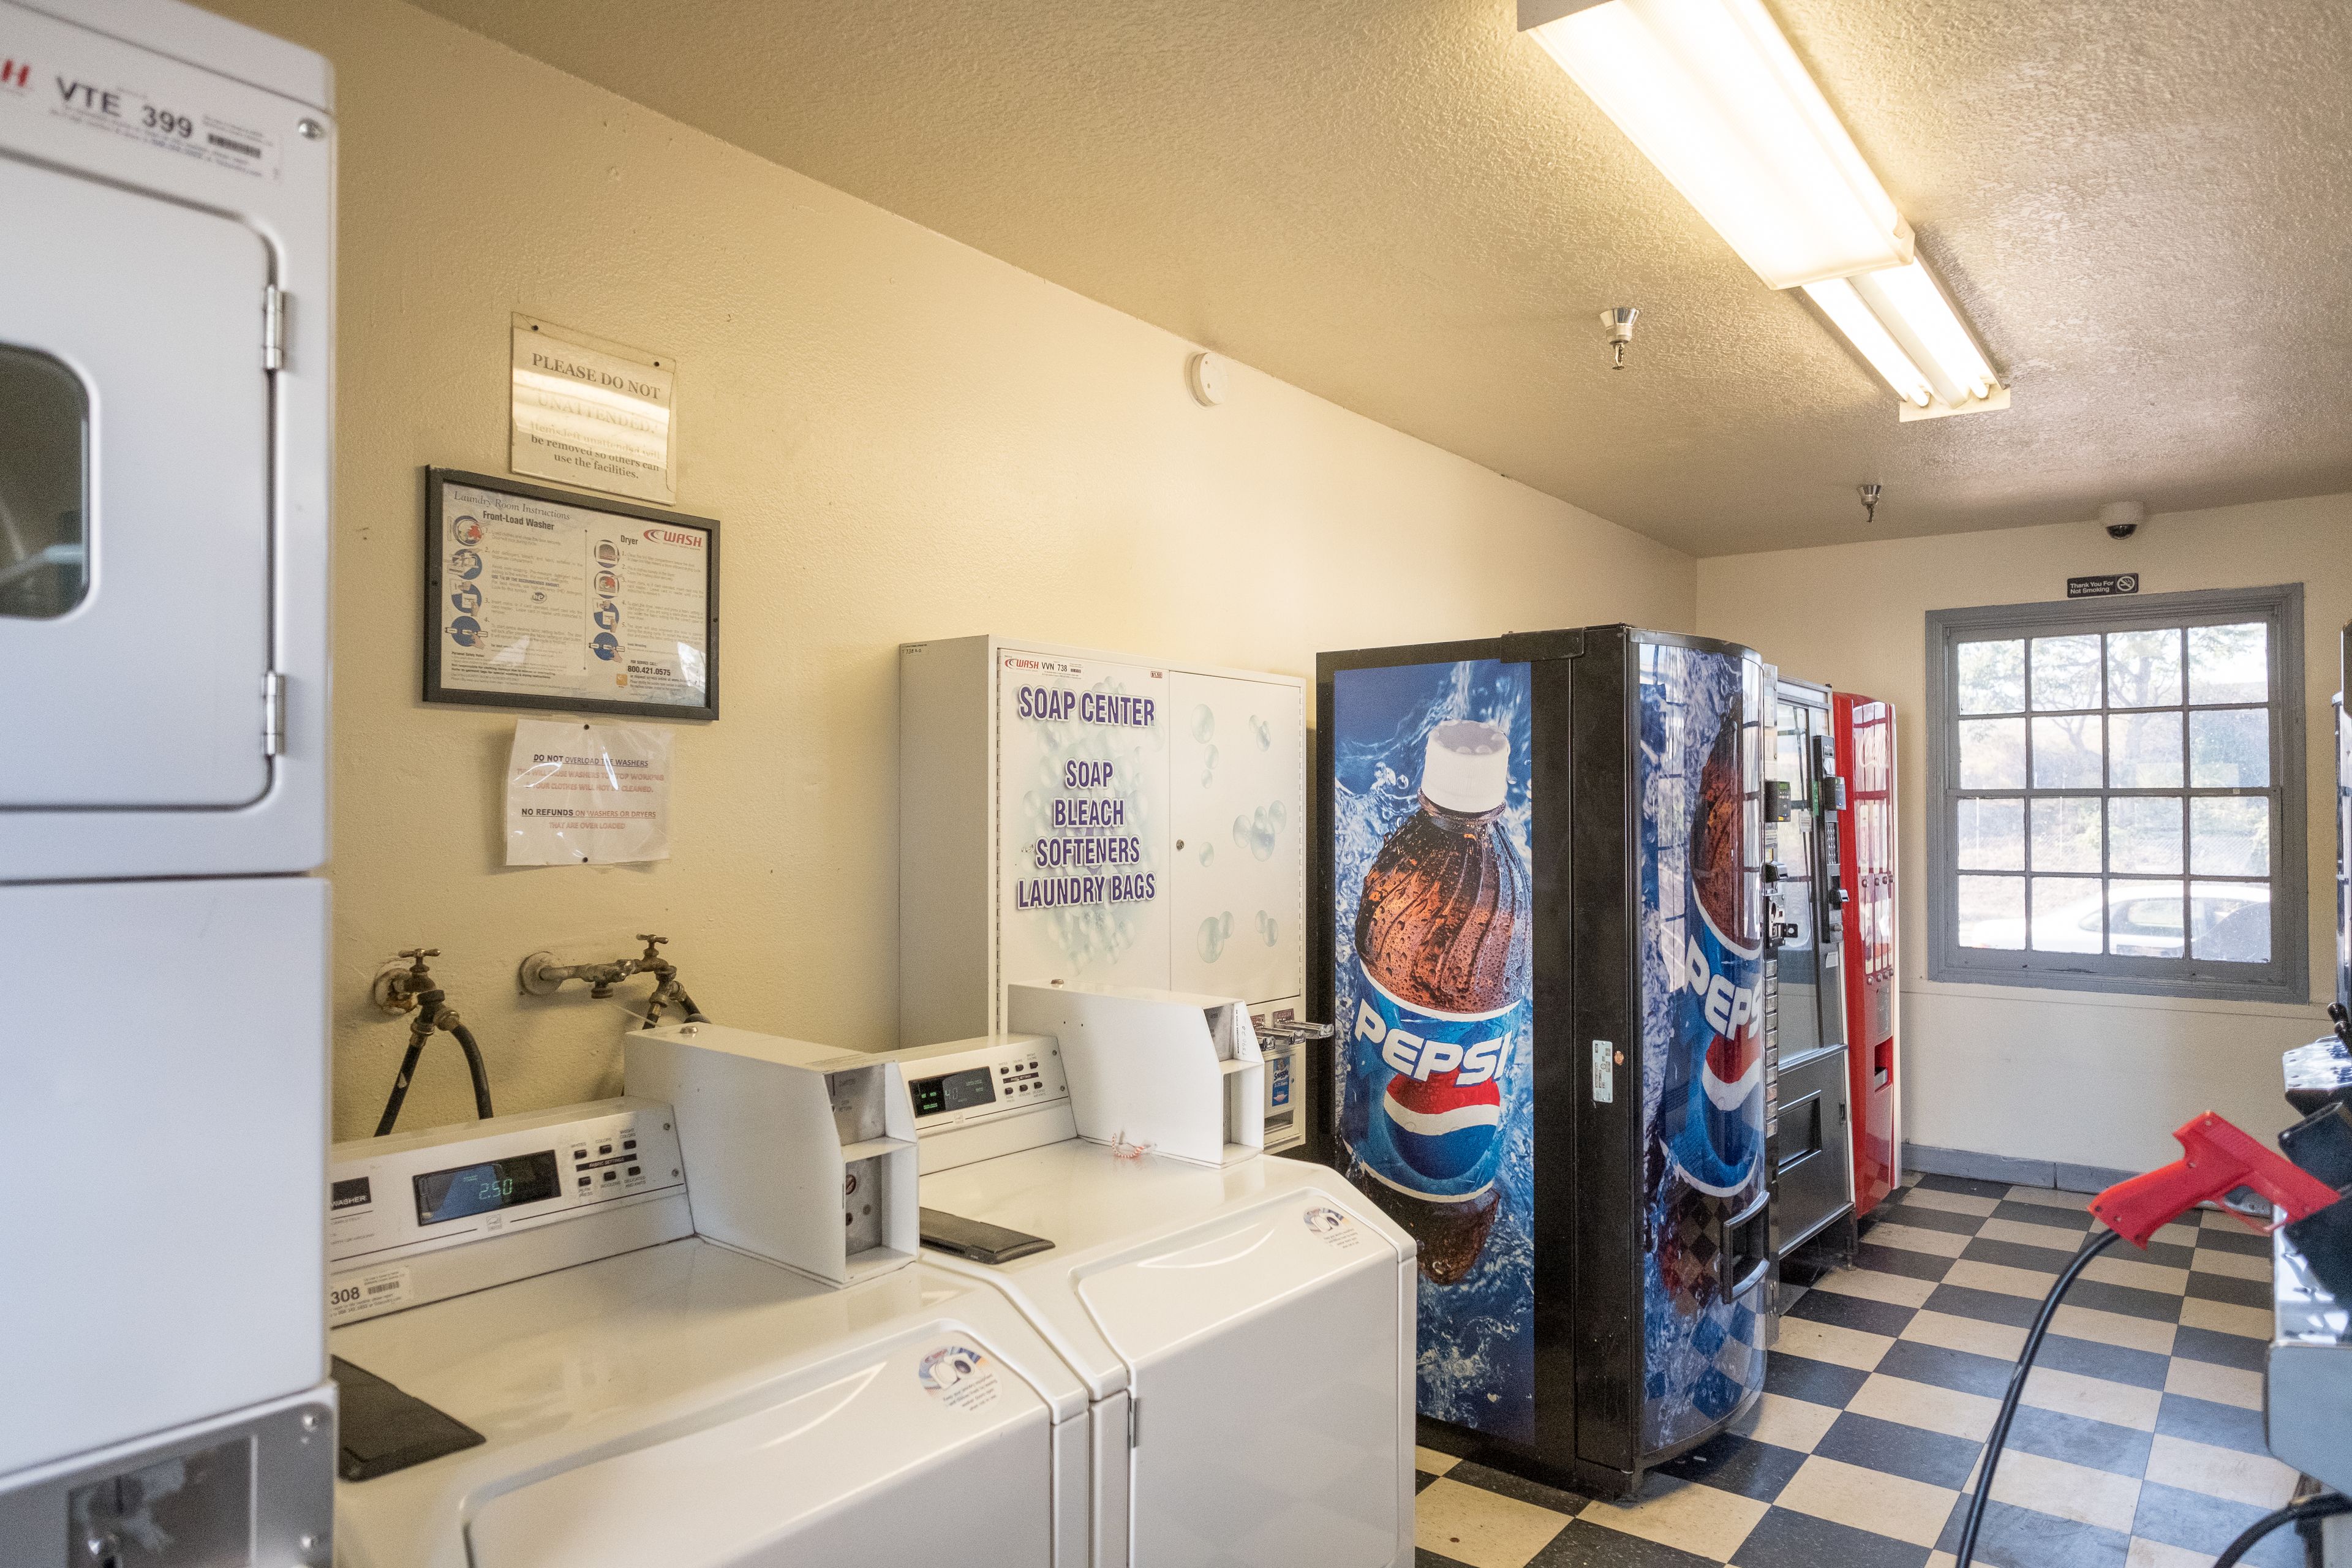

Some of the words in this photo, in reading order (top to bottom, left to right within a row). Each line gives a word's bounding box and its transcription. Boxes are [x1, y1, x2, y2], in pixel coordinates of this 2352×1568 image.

[55, 75, 122, 118] VTE
[141, 104, 194, 140] 399
[532, 353, 597, 382] PLEASE
[601, 372, 624, 389] DO
[628, 380, 660, 399] NOT
[531, 434, 544, 445] be
[546, 439, 592, 456] removed
[608, 454, 640, 468] others
[643, 462, 659, 472] can
[554, 454, 572, 464] use
[575, 458, 591, 468] the
[594, 461, 639, 479] facilities.
[454, 491, 491, 508] Laundry
[495, 499, 520, 511] Room
[522, 503, 570, 520] Instructions
[483, 510, 524, 526] Front-Load
[526, 518, 555, 530] Washer
[620, 535, 638, 546] Dryer
[663, 530, 703, 548] WASH
[627, 665, 671, 676] 800.421.0575
[1016, 658, 1039, 669] WASH
[1041, 662, 1054, 671] VVN
[1057, 663, 1068, 672] 738
[1019, 685, 1076, 720] SOAP
[1081, 692, 1155, 726] CENTER
[1066, 760, 1113, 788] SOAP
[1055, 799, 1124, 826] BLEACH
[1036, 837, 1140, 867] SOFTENERS
[1019, 875, 1105, 908] LAUNDRY
[1112, 873, 1155, 901] BAGS
[1681, 934, 1762, 1041] PEPS
[1354, 998, 1513, 1085] PEPSI
[331, 1194, 368, 1207] WASHER
[479, 1178, 513, 1200] 2.50
[331, 1287, 360, 1305] 308
